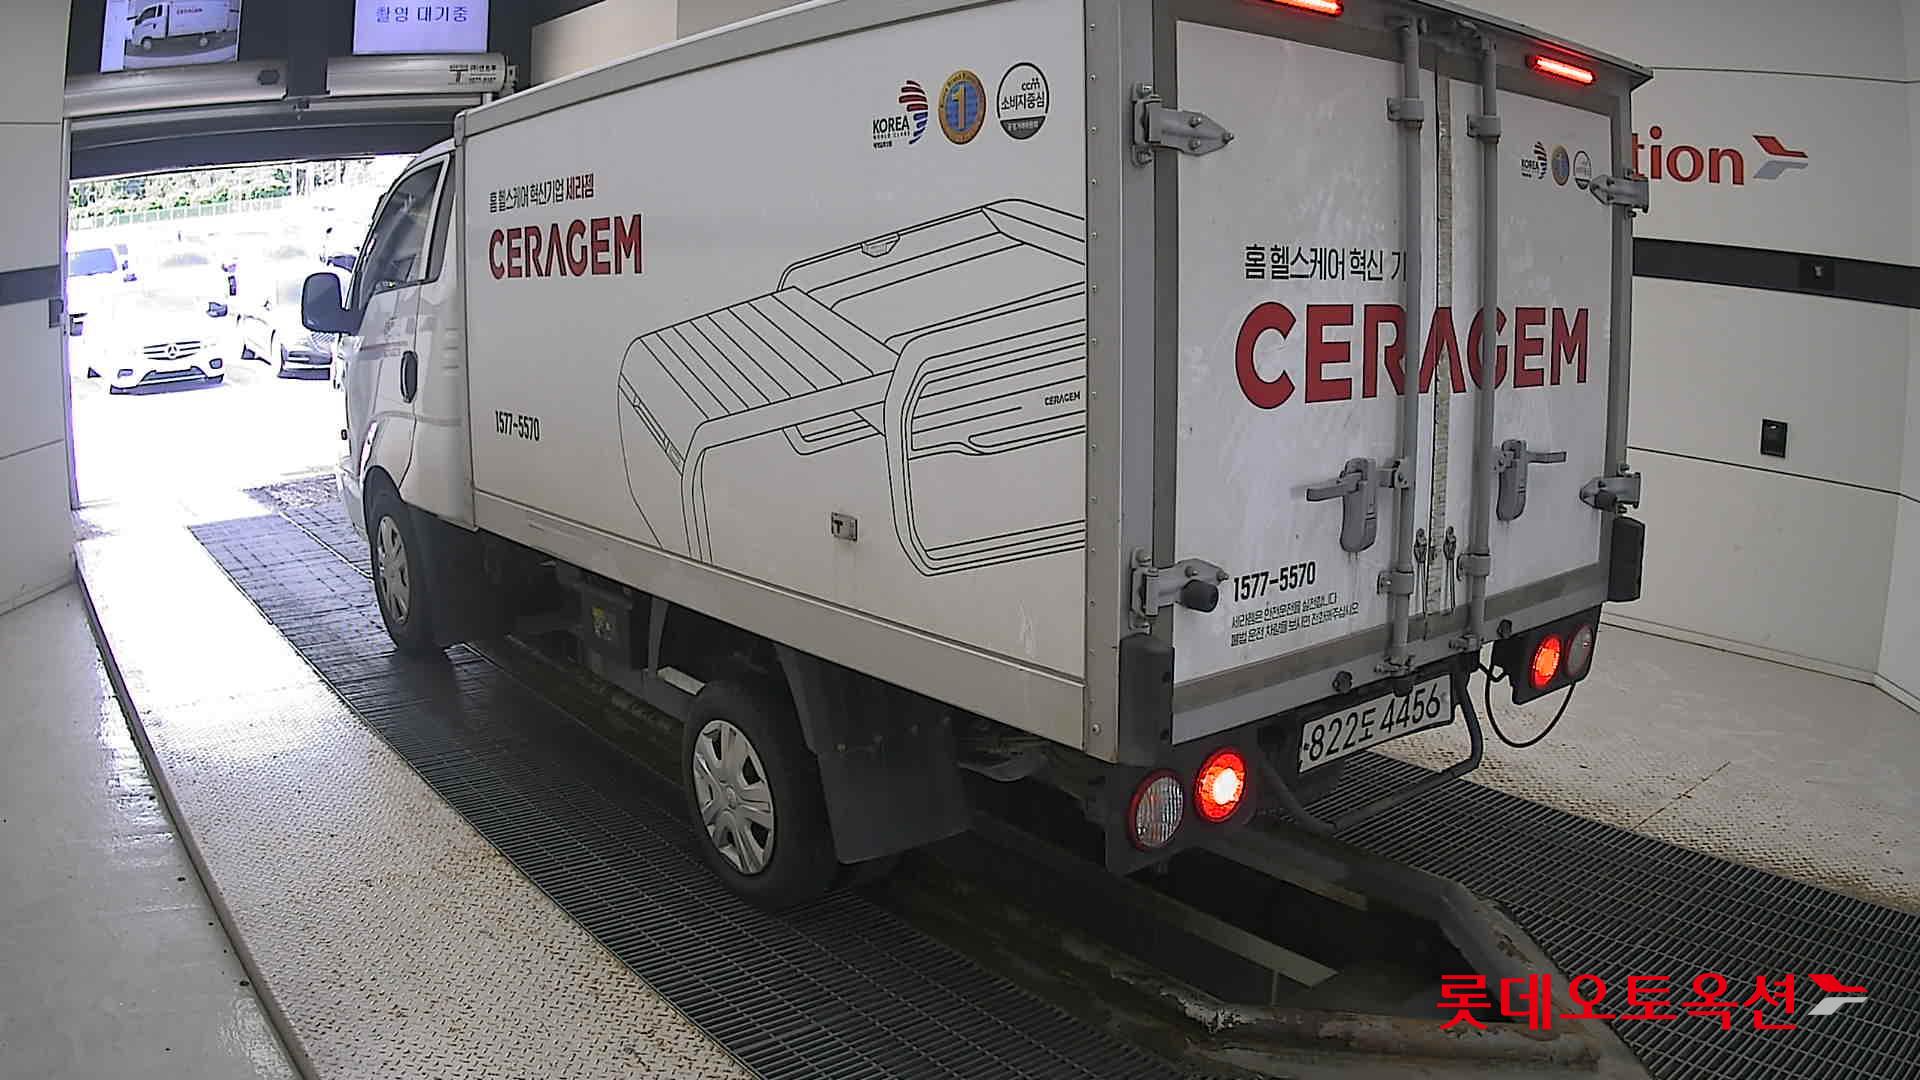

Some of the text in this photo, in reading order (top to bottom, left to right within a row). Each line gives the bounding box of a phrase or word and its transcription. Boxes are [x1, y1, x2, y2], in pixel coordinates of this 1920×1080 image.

[417, 5, 468, 23] 대기중
[872, 115, 910, 134] KOREA
[1631, 125, 1744, 186] tion
[565, 172, 594, 200] 세라젬
[488, 213, 643, 281] CERAGEM
[1244, 244, 1266, 280] 홈
[1270, 244, 1345, 281] 헬스케어
[1349, 247, 1384, 282] 혁신
[1234, 300, 1590, 410] CERAGEM
[495, 410, 540, 442] 1577-5570
[1233, 561, 1316, 602] 1577-5570
[1309, 682, 1441, 762] 822도 4456
